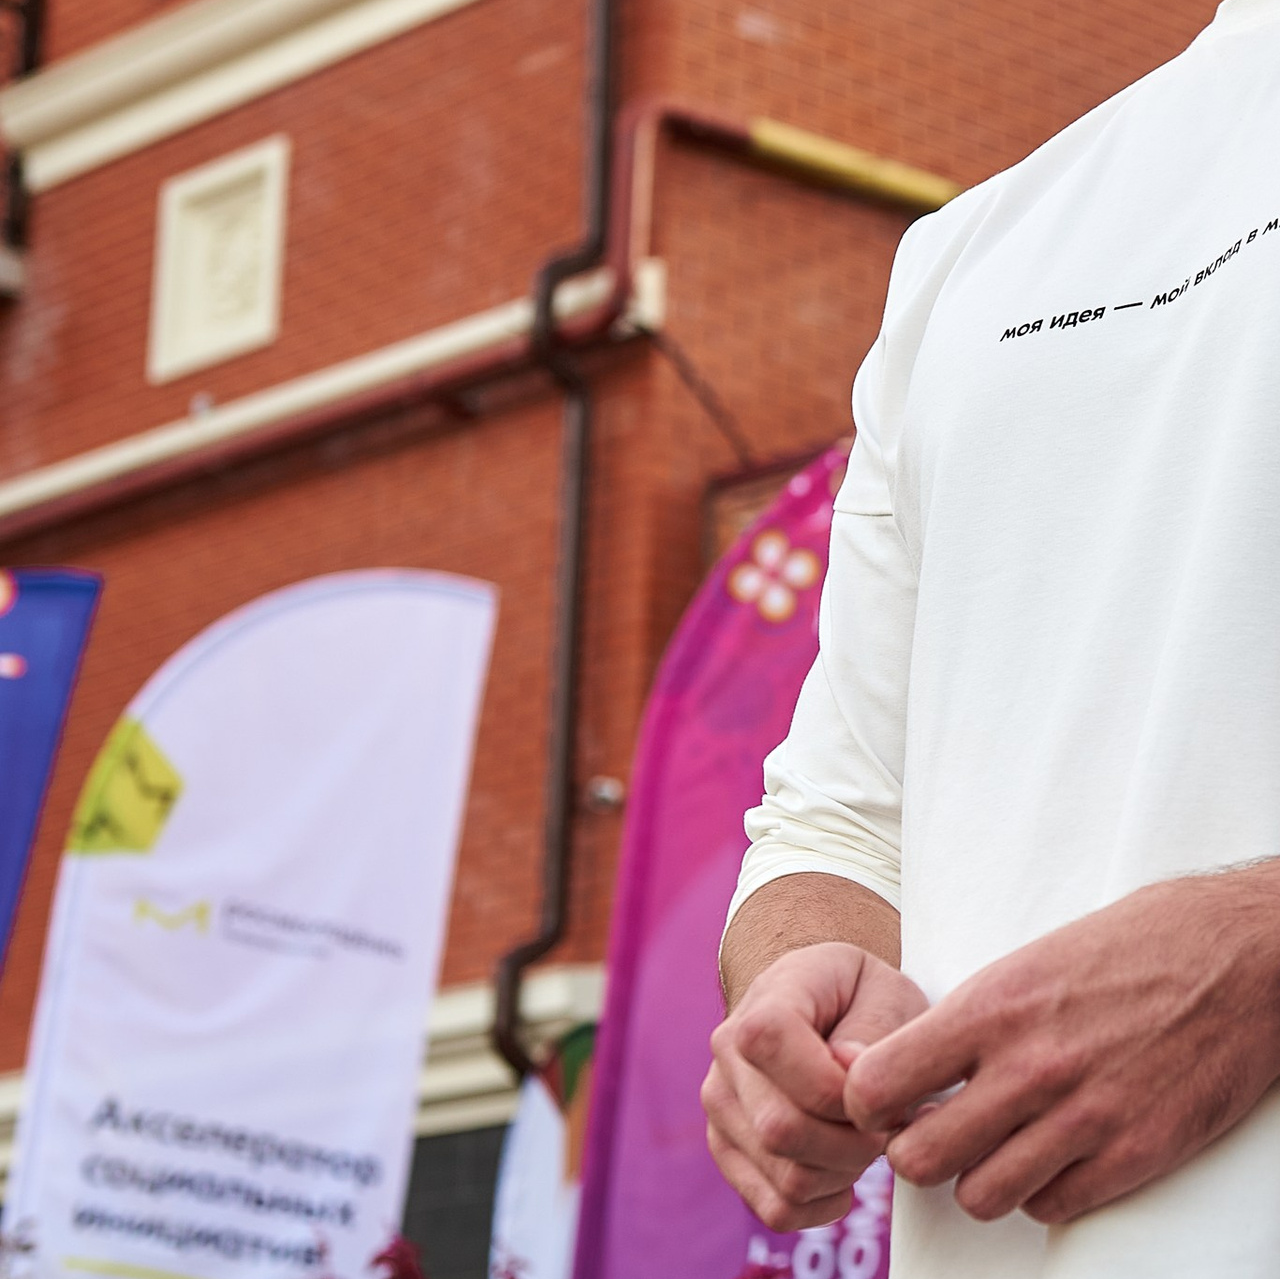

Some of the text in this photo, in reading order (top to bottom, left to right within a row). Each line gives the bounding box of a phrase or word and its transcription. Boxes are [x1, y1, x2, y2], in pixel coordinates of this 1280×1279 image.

[999, 318, 1044, 342] моя
[1049, 306, 1106, 330] идея
[1149, 276, 1191, 309] мой
[1193, 238, 1243, 287] вклад
[1246, 228, 1259, 244] в
